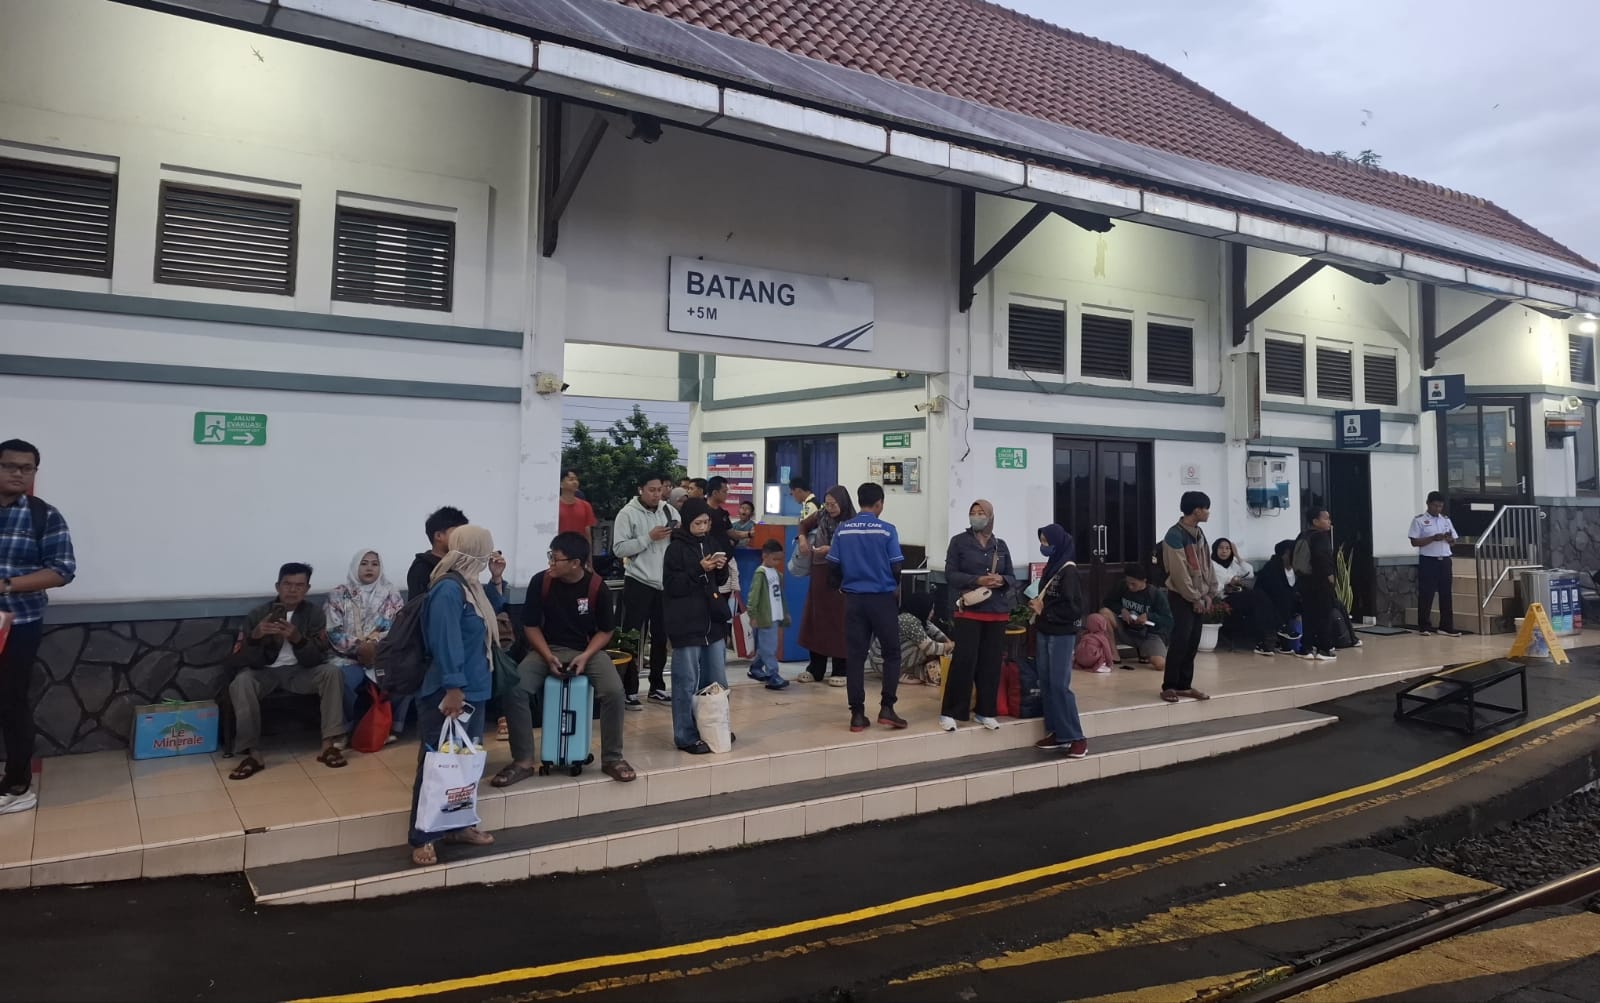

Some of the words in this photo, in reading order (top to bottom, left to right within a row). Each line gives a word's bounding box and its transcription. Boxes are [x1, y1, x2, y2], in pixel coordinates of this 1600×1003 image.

[686, 270, 796, 306] BATANG
[686, 306, 718, 321] +5M
[171, 727, 185, 738] Le
[152, 735, 204, 749] Minerale
